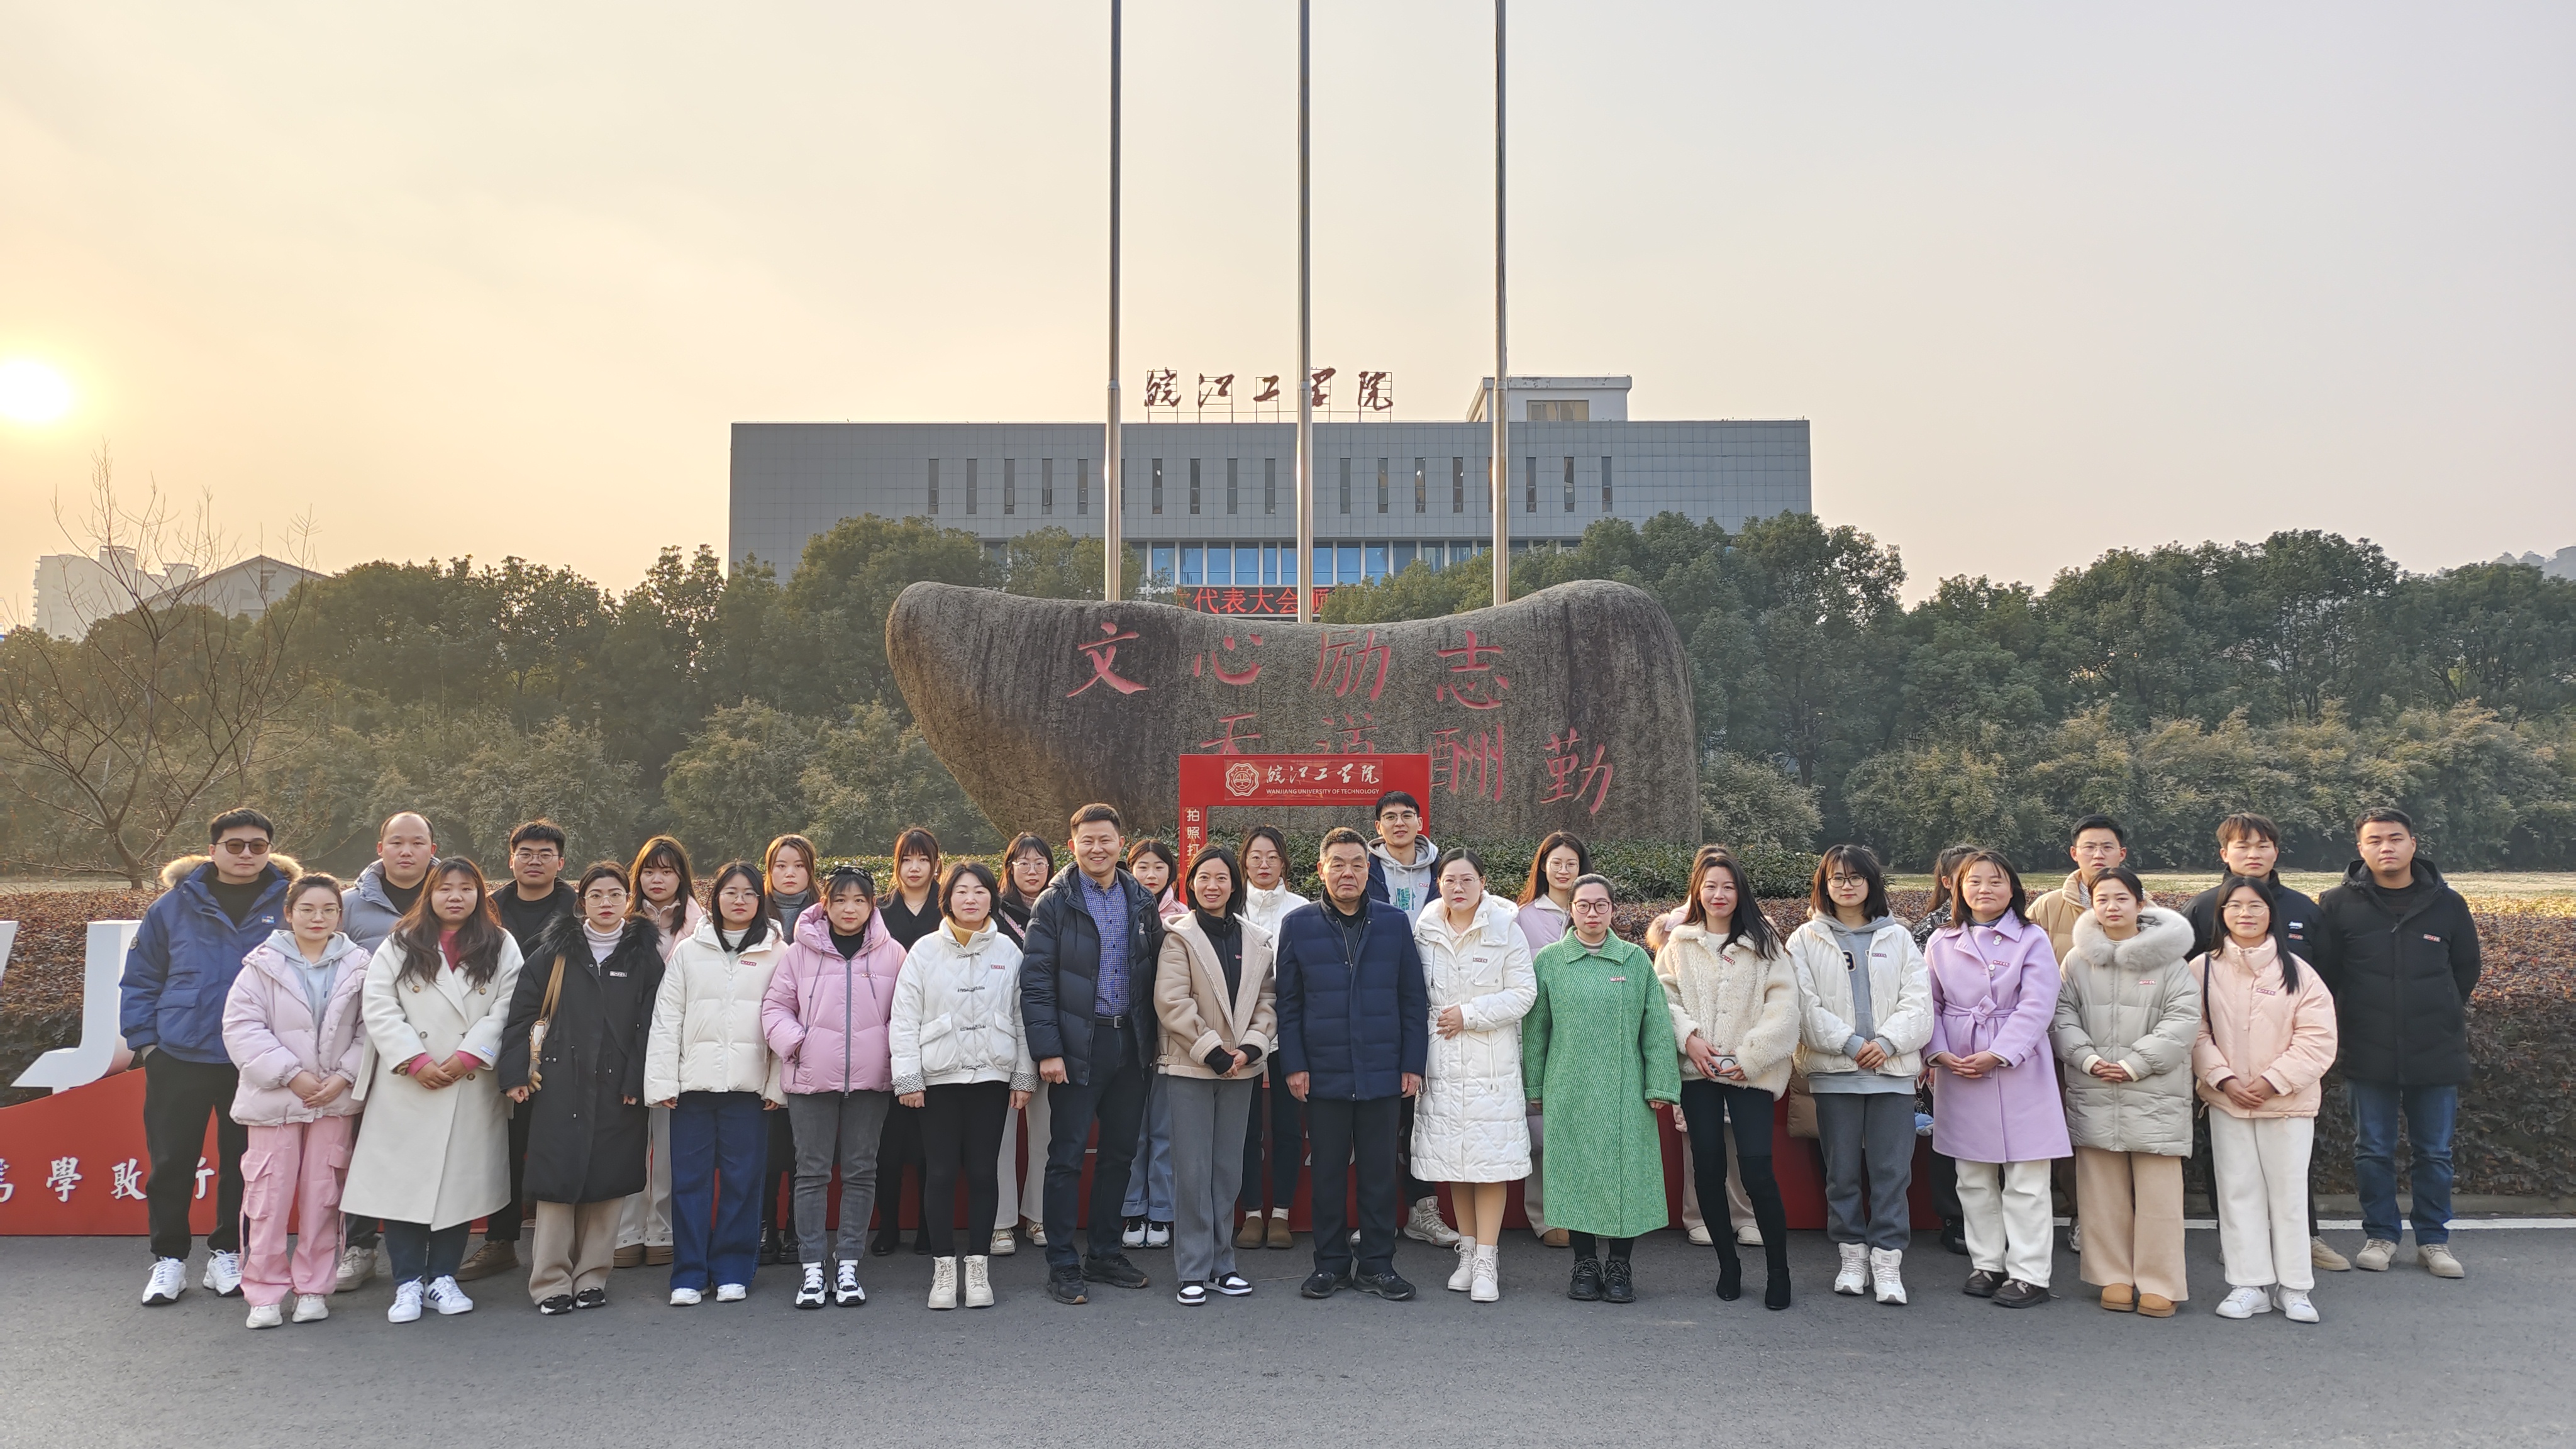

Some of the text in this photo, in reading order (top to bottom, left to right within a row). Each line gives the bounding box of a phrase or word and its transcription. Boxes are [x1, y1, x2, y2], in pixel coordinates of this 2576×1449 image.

[1144, 367, 1393, 411] 皖江工学院
[1067, 621, 1509, 710] 文心励志
[1266, 763, 1380, 784] 皖江工学院
[1186, 808, 1200, 867] 拍照打
